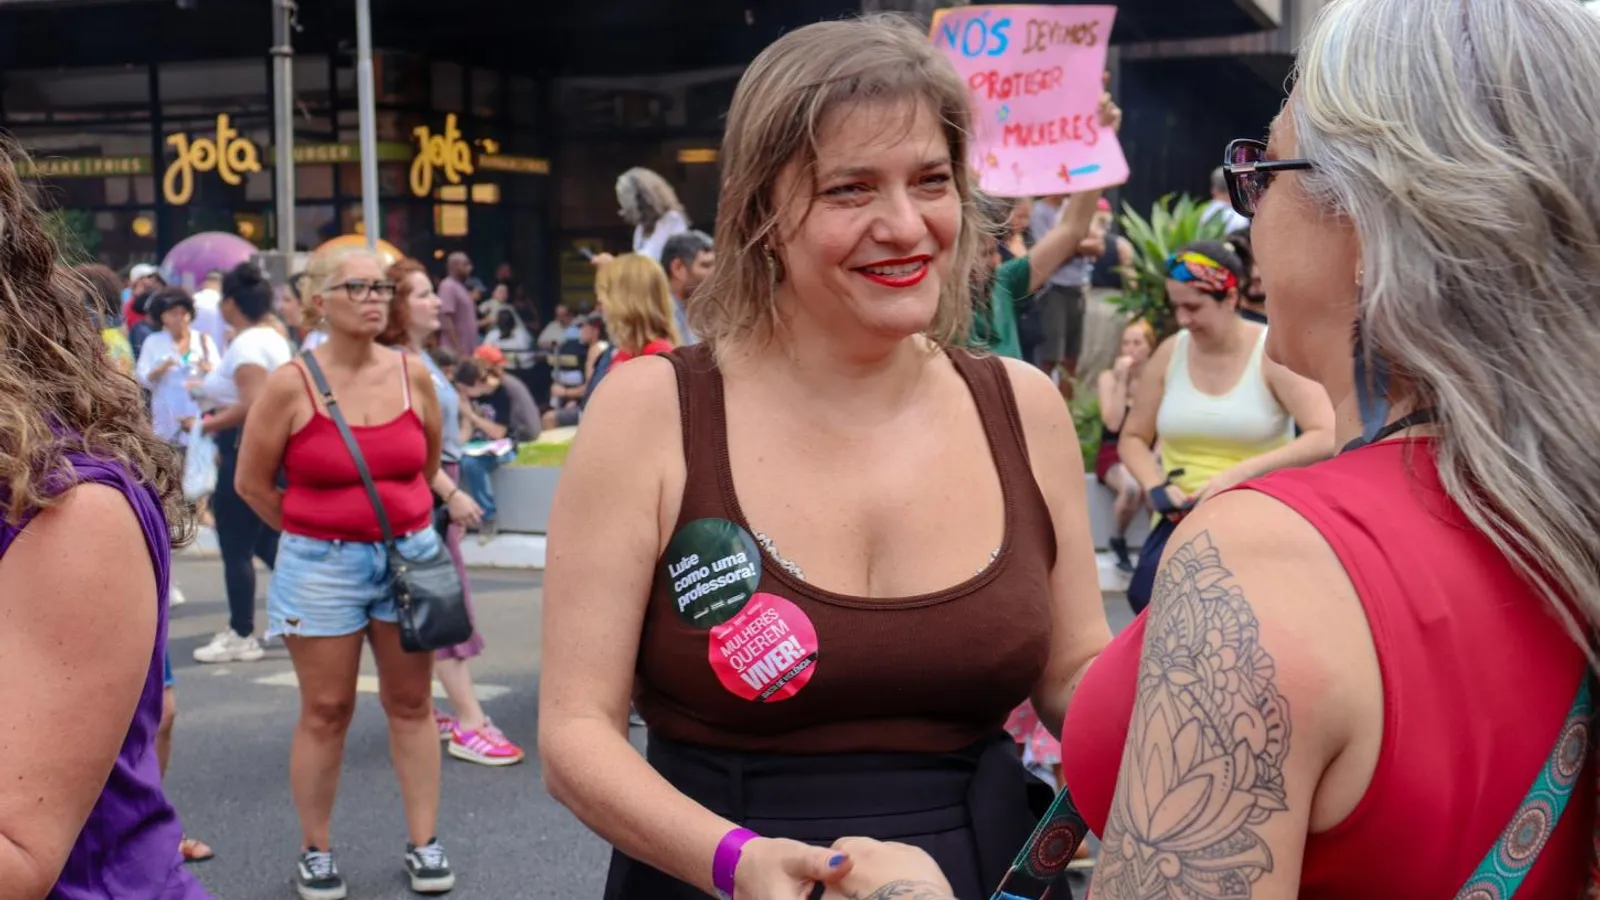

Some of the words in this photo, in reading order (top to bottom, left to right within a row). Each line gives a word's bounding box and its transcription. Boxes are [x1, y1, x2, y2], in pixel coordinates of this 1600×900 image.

[934, 11, 1012, 57] NÓS
[294, 145, 349, 161] URGER
[668, 553, 700, 579] Lute
[674, 566, 710, 592] como
[711, 552, 748, 573] uma
[677, 562, 757, 612] professora!
[720, 607, 780, 658] MULHERES
[729, 619, 790, 673] QUEREM
[740, 635, 807, 691] VIVER!
